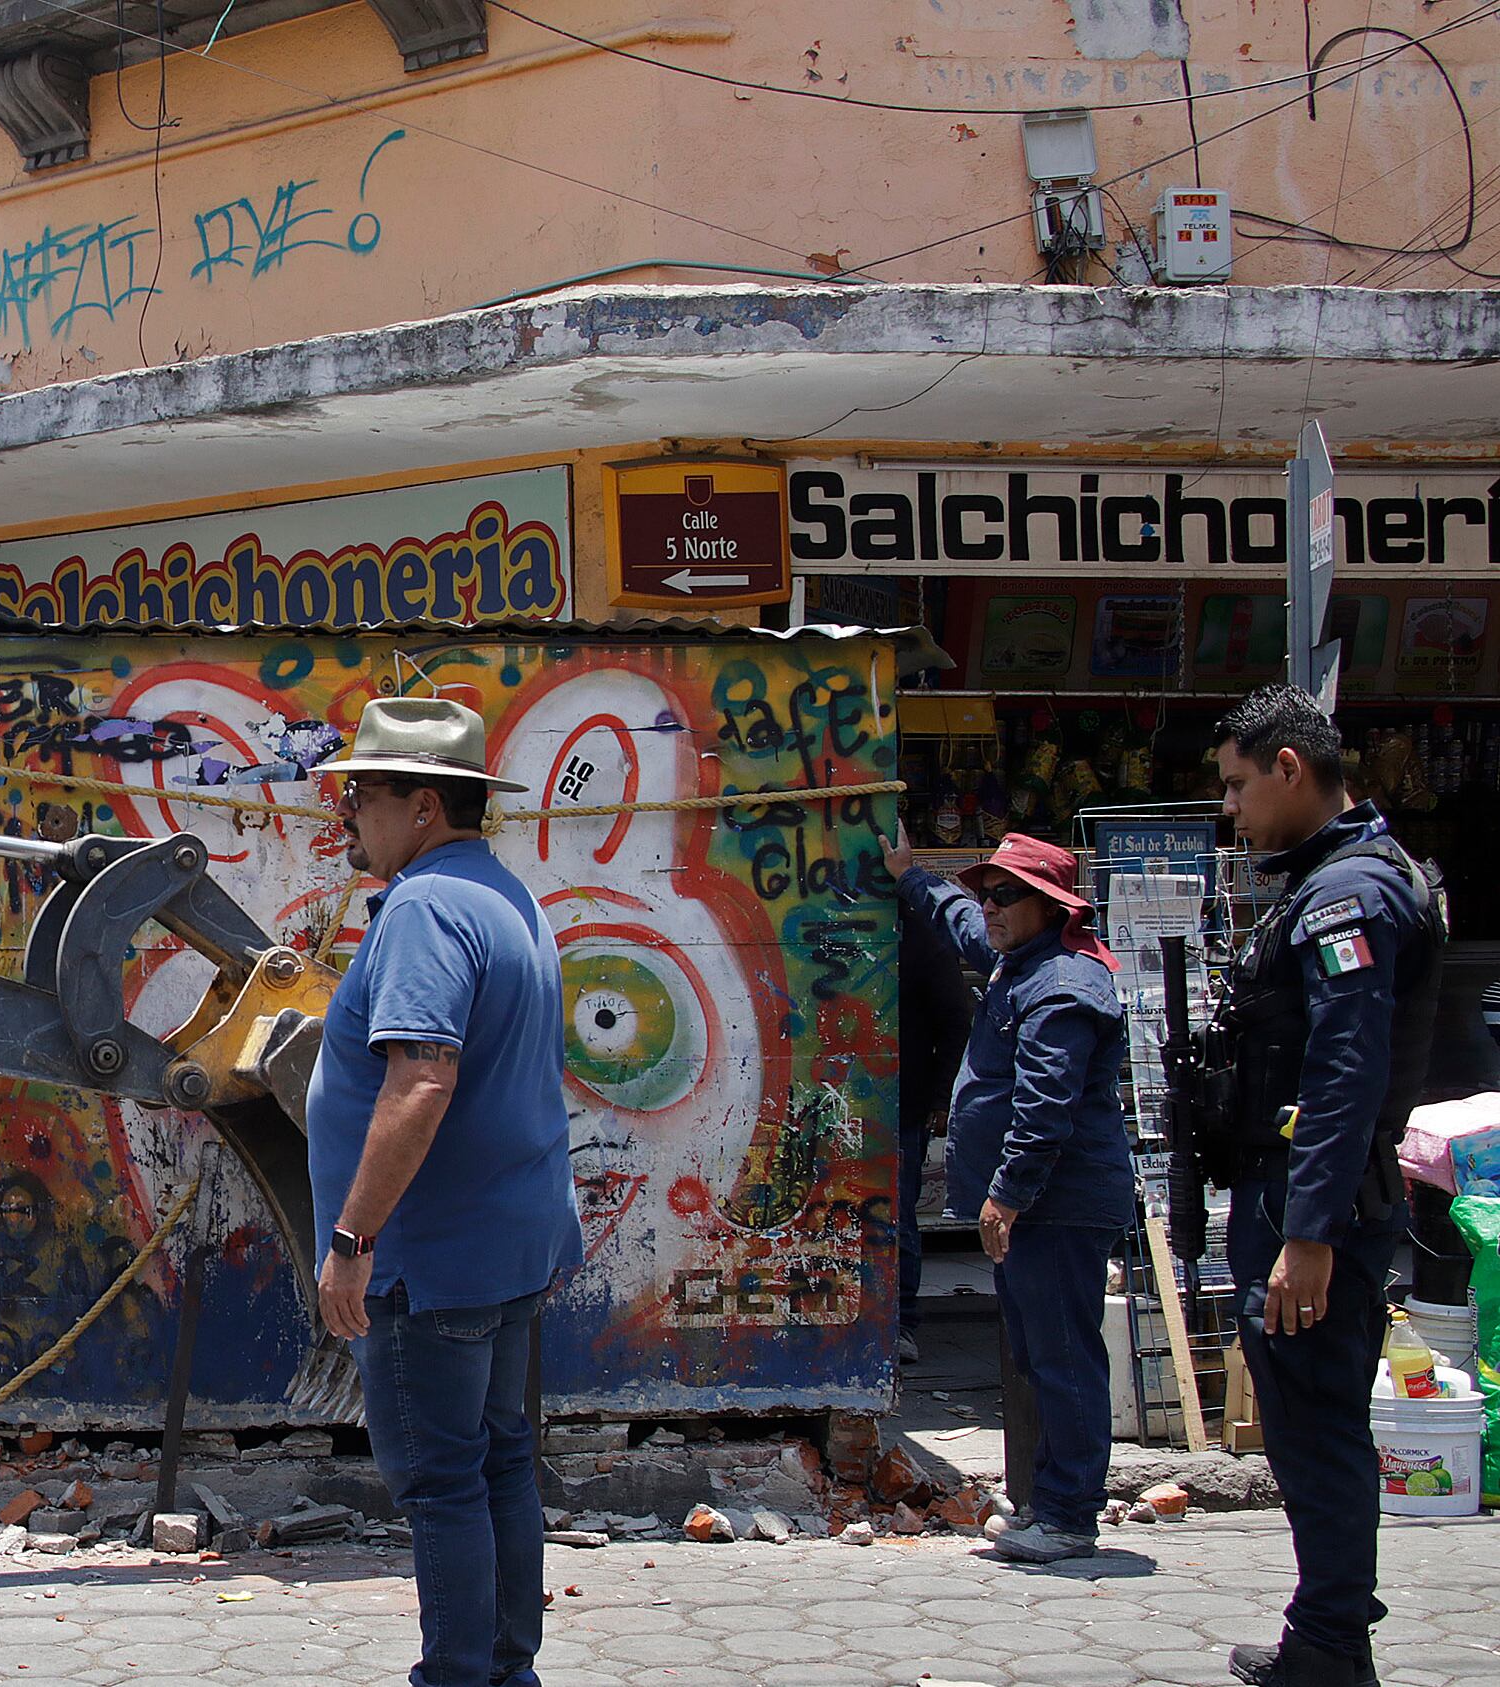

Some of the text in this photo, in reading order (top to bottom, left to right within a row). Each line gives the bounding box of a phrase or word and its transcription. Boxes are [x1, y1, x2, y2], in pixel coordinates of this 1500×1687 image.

[682, 511, 718, 529] Calle
[666, 536, 738, 560] 5 Norte
[1109, 833, 1204, 853] El Sol de Puebla
[1319, 928, 1361, 946] MÉXICO
[1389, 1447, 1430, 1457] McCORMICK
[1381, 1457, 1431, 1473] Mayonesa
